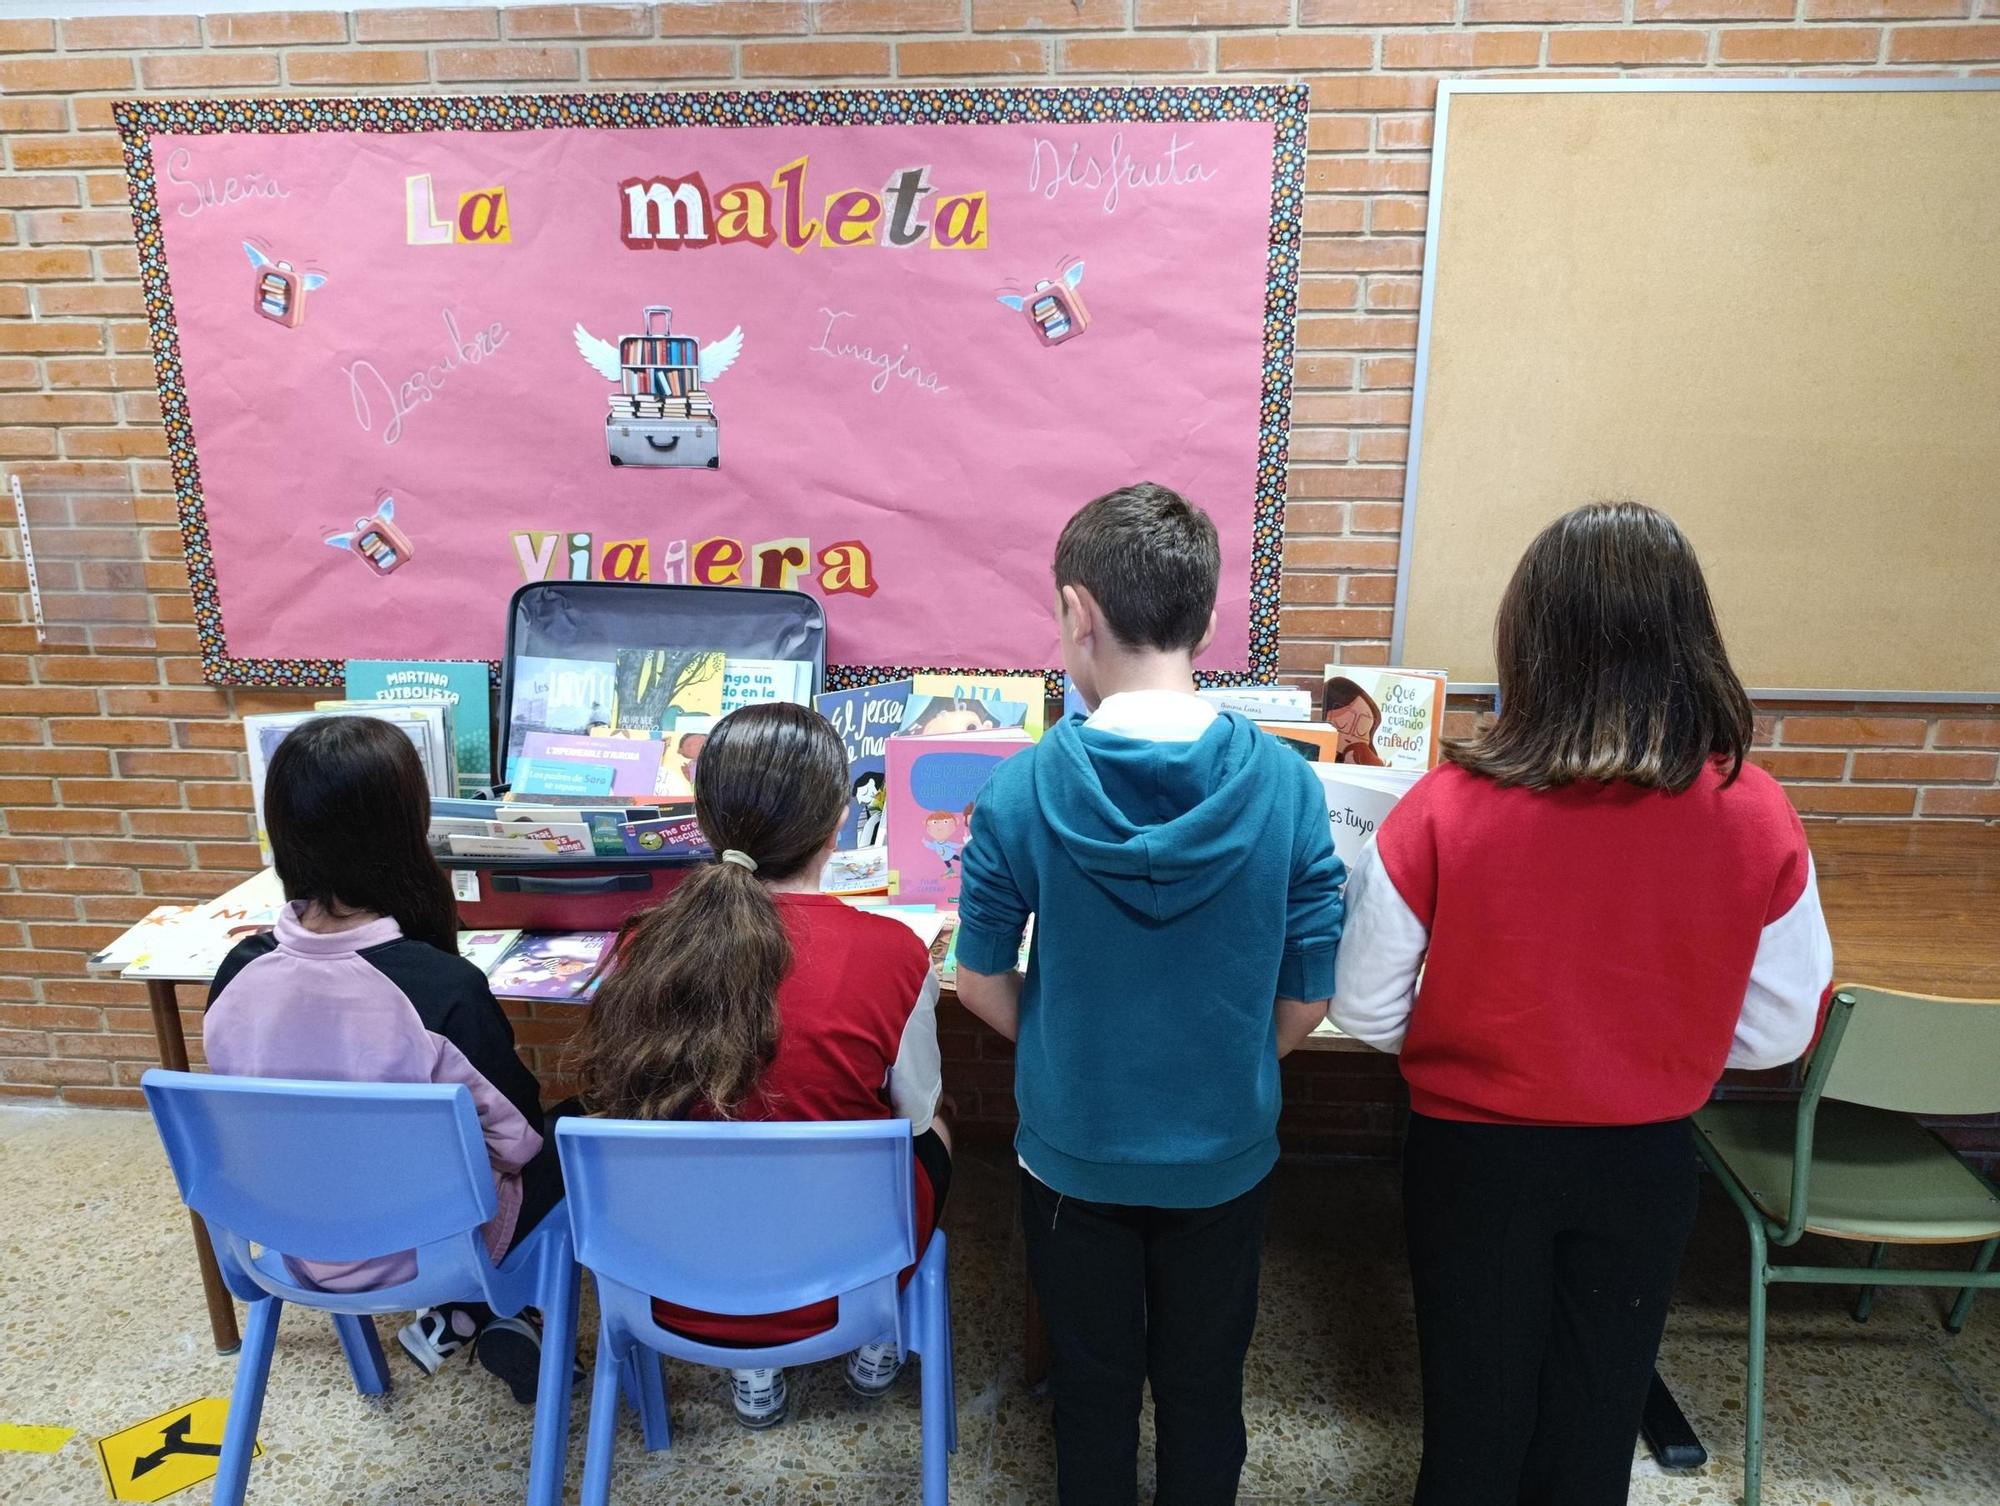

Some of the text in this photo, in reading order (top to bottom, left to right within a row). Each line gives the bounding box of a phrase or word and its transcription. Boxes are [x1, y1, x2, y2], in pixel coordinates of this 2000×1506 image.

[166, 147, 291, 218] Sueña
[1029, 132, 1217, 214] Disfruta
[405, 160, 986, 250] La maleta
[809, 306, 949, 393] Imagina
[340, 307, 510, 445] Descubre
[386, 670, 449, 688] MARTINA
[725, 674, 772, 686] ngo un
[375, 686, 460, 705] FUTBOLISTA
[723, 685, 775, 697] do en la
[1386, 684, 1415, 703] ¿Qué
[1381, 703, 1426, 718] necesito
[1388, 716, 1424, 730] cuando
[1377, 733, 1424, 752] enfado?
[659, 821, 698, 838] The Gre
[668, 829, 701, 845] Biscuit
